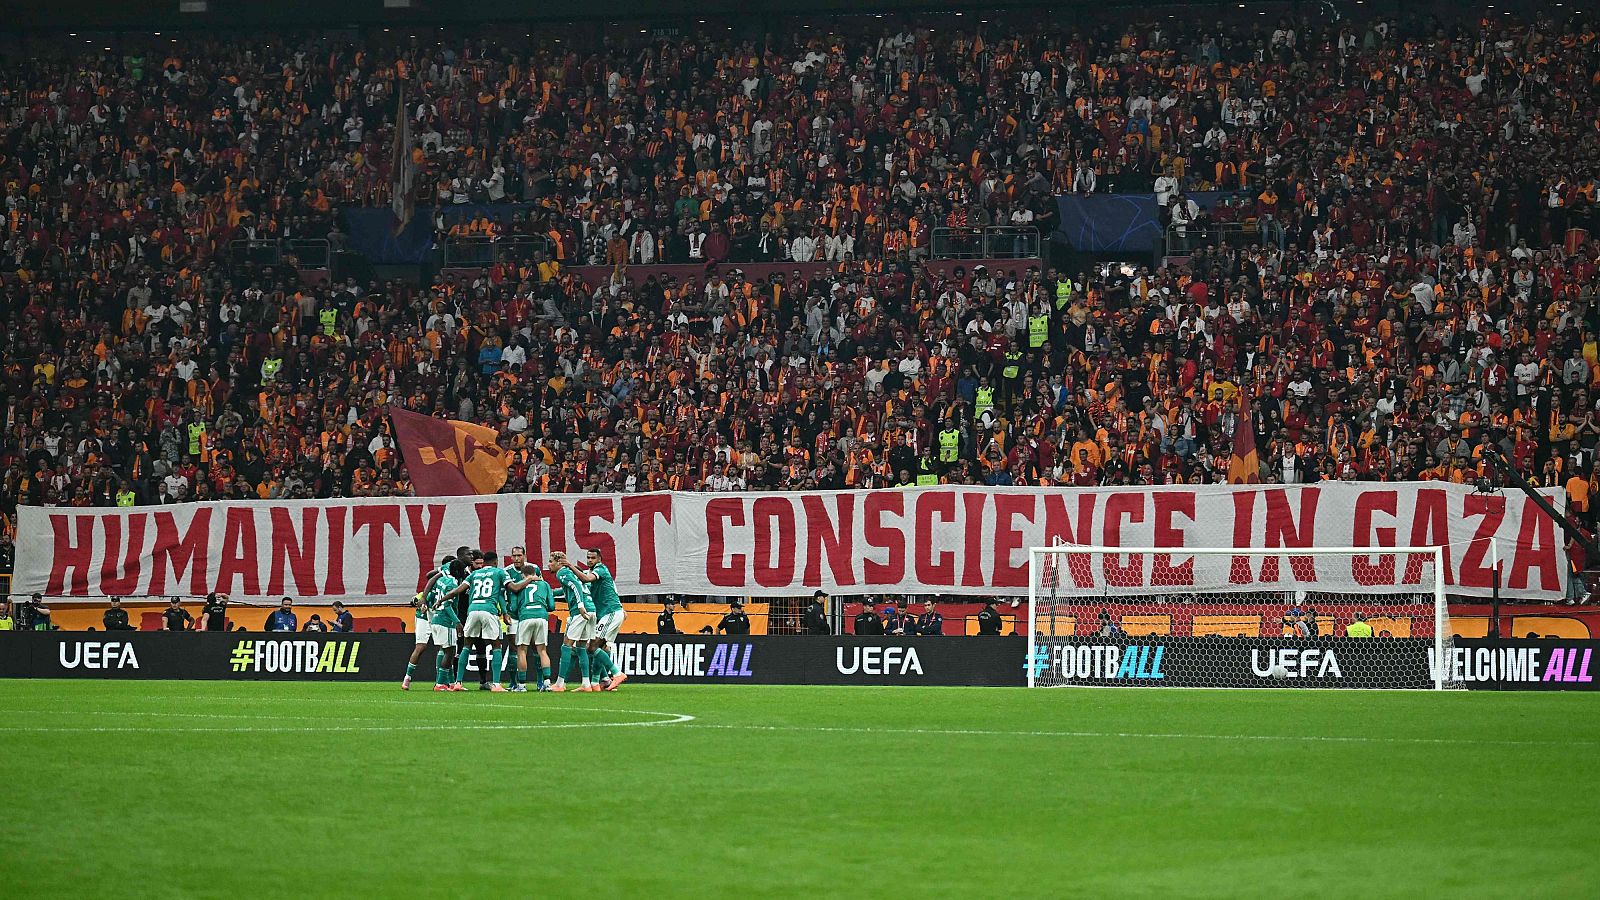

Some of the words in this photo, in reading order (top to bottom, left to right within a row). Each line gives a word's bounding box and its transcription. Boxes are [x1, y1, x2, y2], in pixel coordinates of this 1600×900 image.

[46, 504, 447, 596] HUMANITY
[475, 493, 671, 589] LOST
[706, 492, 1196, 588] CONSCIENCE
[1229, 487, 1321, 584] IN
[1351, 487, 1561, 592] GAZA
[473, 578, 494, 599] 38
[525, 583, 538, 603] 7
[59, 641, 139, 669] UEFA
[230, 640, 360, 673] #FOOTBALL
[706, 643, 753, 677] ALL
[836, 646, 924, 675] UEFA
[1022, 645, 1165, 679] #FOOTBALL
[1251, 648, 1343, 677] UEFA
[1427, 647, 1540, 682] WELCOME
[1542, 648, 1593, 682] ALL
